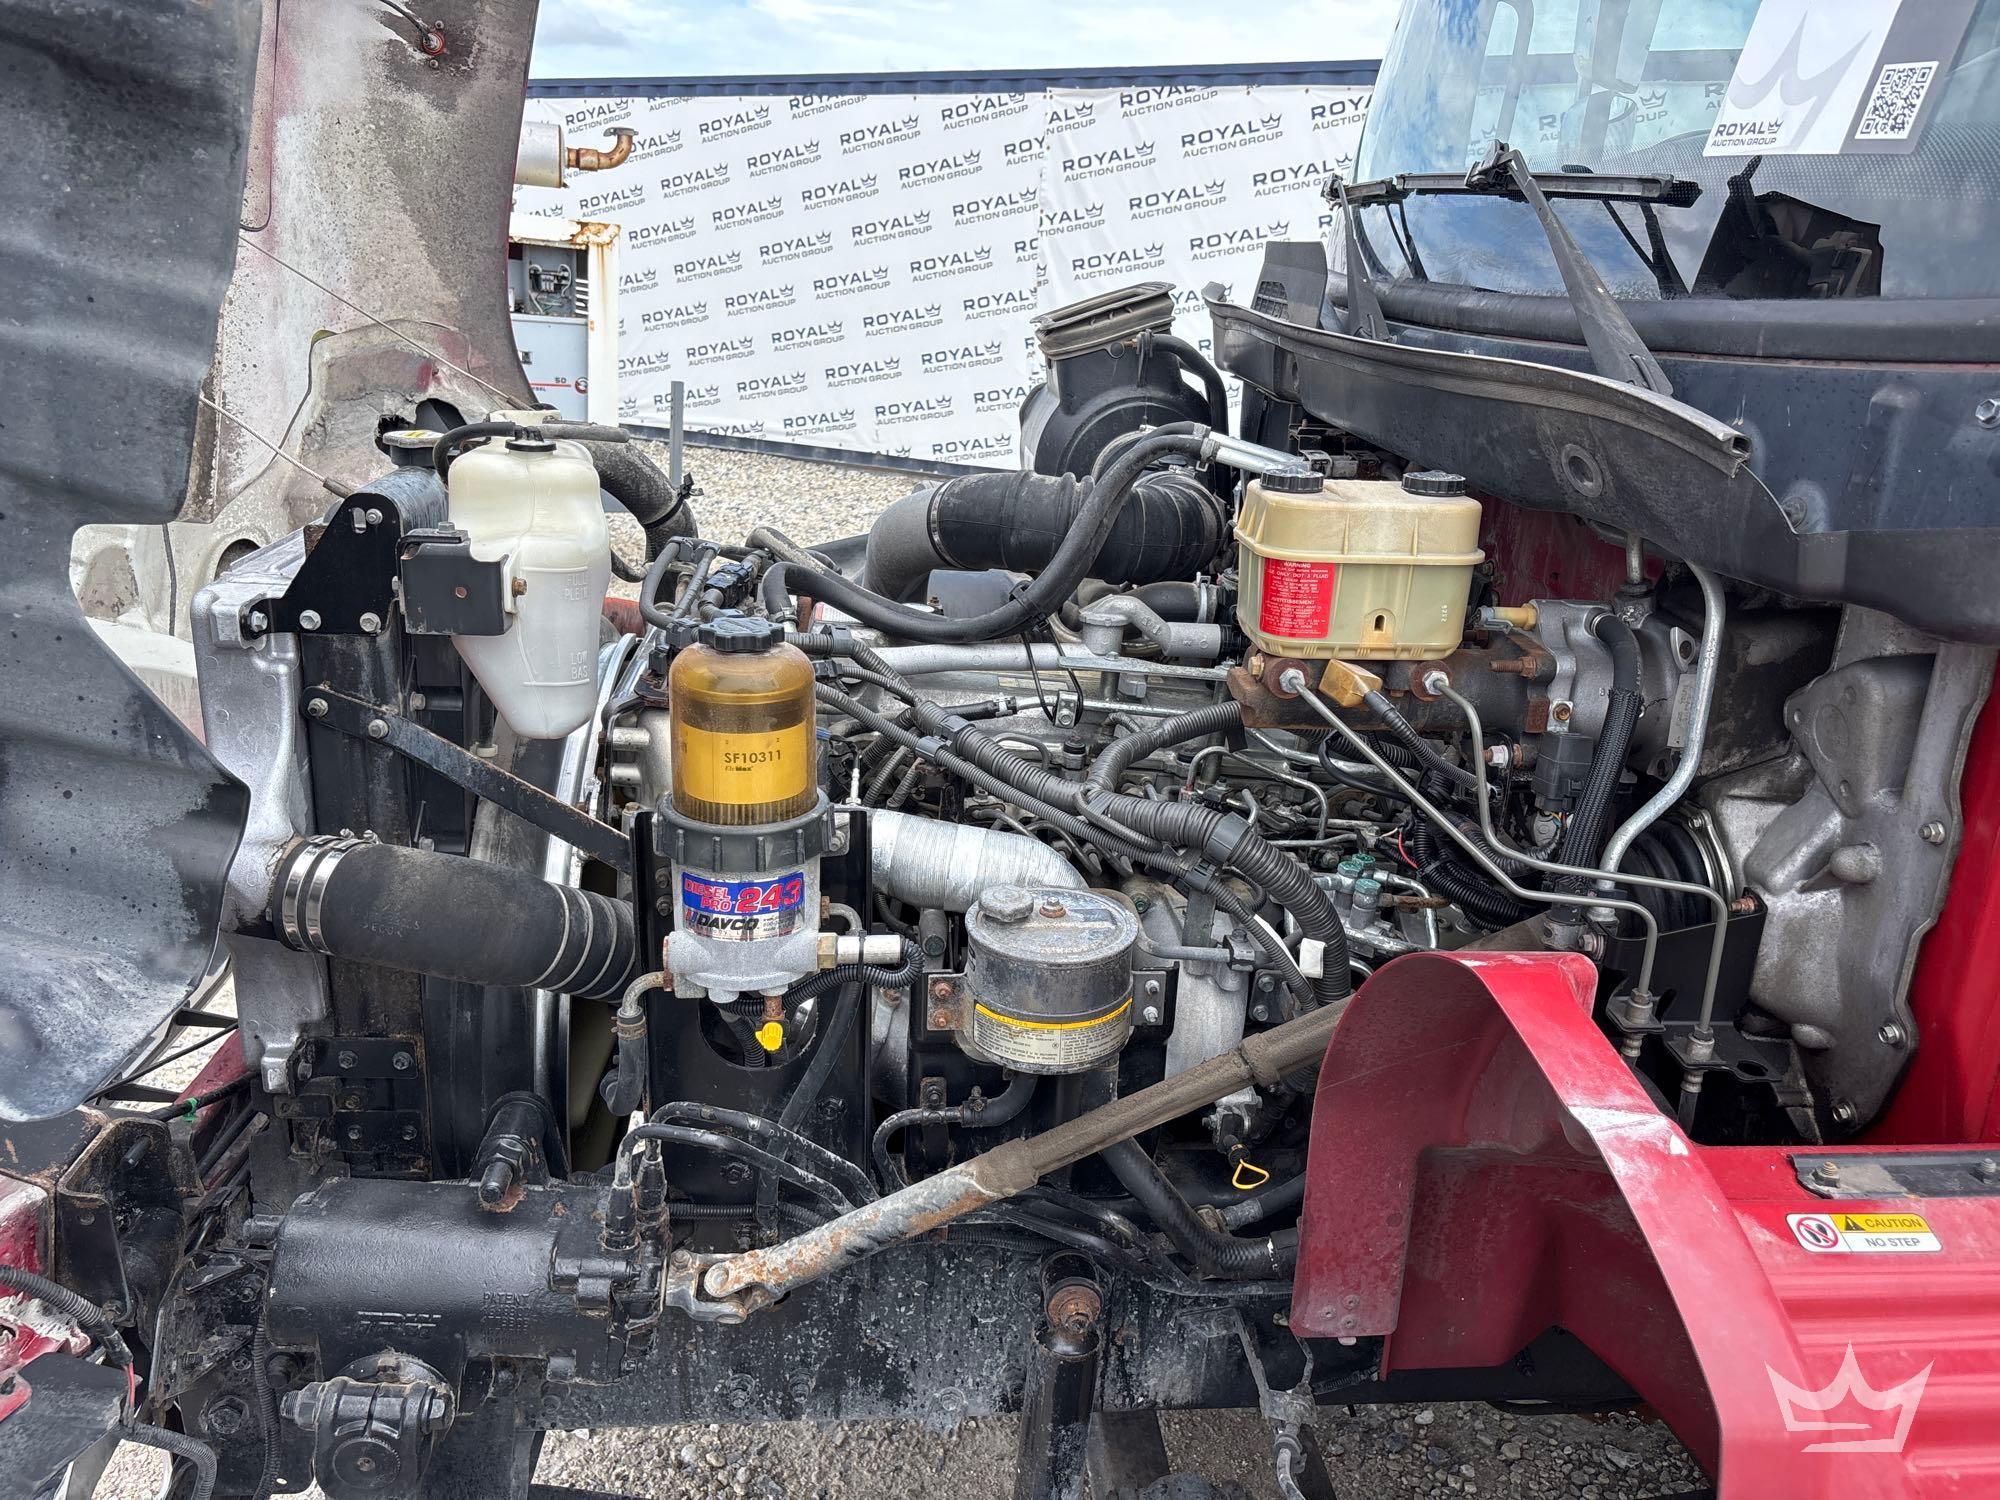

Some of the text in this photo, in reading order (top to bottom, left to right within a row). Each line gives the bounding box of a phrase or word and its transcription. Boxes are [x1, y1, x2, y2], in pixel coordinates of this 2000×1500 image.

[792, 104, 832, 120] AUCTION
[941, 96, 1007, 122] ROYAL
[1121, 90, 1218, 119] AUCTION GROUP
[565, 104, 615, 126] ROYAL
[568, 112, 631, 134] AUCTION GROUP
[699, 110, 754, 135] ROYAL
[944, 114, 989, 131] AUCTION
[991, 104, 1028, 119] GROUP
[702, 120, 772, 144] AUCTION GROUP
[840, 120, 902, 146] ROYAL
[1056, 118, 1096, 133] GROUP
[1181, 119, 1260, 148] ROYAL
[1715, 121, 1766, 137] ROYAL
[654, 144, 683, 156] GROUP
[842, 130, 920, 155] AUCTION GROUP
[1183, 131, 1283, 158] AUCTION GROUP
[1711, 137, 1777, 148] AUCTION GROUP
[747, 144, 804, 169] ROYAL
[750, 155, 821, 178] AUCTION GROUP
[1062, 146, 1135, 172] ROYAL
[898, 155, 963, 180] ROYAL
[1064, 158, 1156, 182] AUCTION GROUP
[1253, 160, 1335, 187] ROYAL
[660, 168, 712, 190] ROYAL
[664, 177, 730, 198] AUCTION GROUP
[901, 166, 982, 190] AUCTION GROUP
[802, 178, 861, 202] ROYAL
[804, 188, 879, 211] AUCTION GROUP
[1129, 184, 1204, 210] ROYAL
[1254, 181, 1310, 198] AUCTION
[580, 190, 629, 210] ROYAL
[582, 198, 645, 218] AUCTION GROUP
[952, 193, 1019, 217] ROYAL
[1131, 196, 1226, 220] AUCTION GROUP
[712, 200, 767, 223] ROYAL
[715, 210, 784, 231] AUCTION GROUP
[955, 203, 1038, 226] AUCTION GROUP
[628, 220, 680, 242] ROYAL
[852, 214, 914, 238] ROYAL
[854, 226, 932, 246] AUCTION GROUP
[1066, 219, 1105, 233] GROUP
[632, 230, 696, 250] AUCTION GROUP
[760, 235, 816, 257] ROYAL
[1190, 227, 1268, 251] ROYAL
[762, 246, 833, 266] AUCTION GROUP
[910, 250, 974, 273] ROYAL
[1072, 248, 1144, 271] ROYAL
[1192, 246, 1245, 262] AUCTION
[674, 254, 726, 275] ROYAL
[677, 264, 742, 283] AUCTION GROUP
[913, 262, 993, 282] AUCTION GROUP
[1074, 259, 1165, 280] AUCTION GROUP
[813, 270, 872, 291] ROYAL
[816, 281, 890, 300] AUCTION GROUP
[725, 288, 780, 308] ROYAL
[728, 299, 796, 316] AUCTION GROUP
[963, 290, 1030, 311] ROYAL
[642, 305, 693, 324] ROYAL
[644, 315, 709, 332] AUCTION GROUP
[863, 308, 925, 328] ROYAL
[965, 307, 1010, 322] AUCTION
[772, 324, 828, 344] ROYAL
[866, 319, 943, 337] AUCTION GROUP
[686, 340, 739, 358] ROYAL
[774, 335, 845, 352] AUCTION GROUP
[618, 355, 656, 370] OYAL
[689, 350, 755, 366] AUCTION GROUP
[921, 344, 984, 365] ROYAL
[825, 361, 884, 380] ROYAL
[924, 356, 1003, 374] AUCTION GROUP
[736, 375, 791, 393] ROYAL
[828, 372, 902, 388] AUCTION GROUP
[740, 386, 808, 400] AUCTION GROUP
[874, 398, 936, 418] ROYAL
[876, 410, 954, 426] AUCTION GROUP
[783, 412, 840, 429] ROYAL
[786, 423, 856, 436] AUCTION GROUP
[932, 437, 995, 455] ROYAL
[978, 449, 1013, 459] GROUP
[724, 749, 781, 764] SF10311
[684, 878, 803, 914] DIESEL 243
[700, 896, 733, 913] PRO
[697, 913, 760, 931] DAVCO
[1864, 1218, 1923, 1228] CAUTION
[1865, 1237, 1921, 1248] NO STEP
